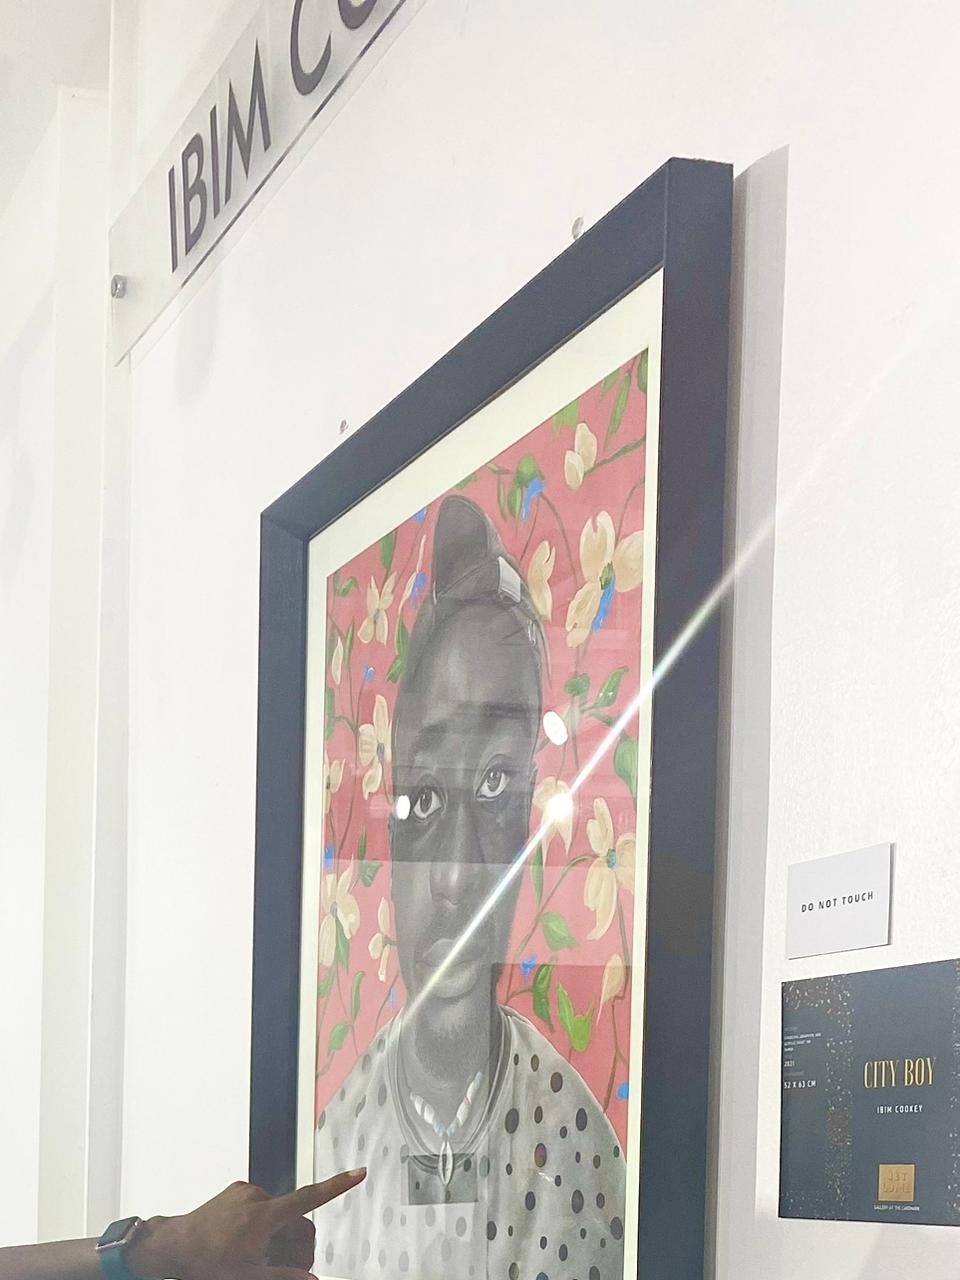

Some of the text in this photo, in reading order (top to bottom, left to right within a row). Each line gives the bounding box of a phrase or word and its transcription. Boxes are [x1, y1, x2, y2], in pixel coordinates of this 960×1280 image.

[168, 37, 271, 274] IBIM
[801, 890, 873, 913] DO NOT TOUCH
[864, 1056, 937, 1089] CITY BOY
[877, 1104, 923, 1114] IBIM COOKEY
